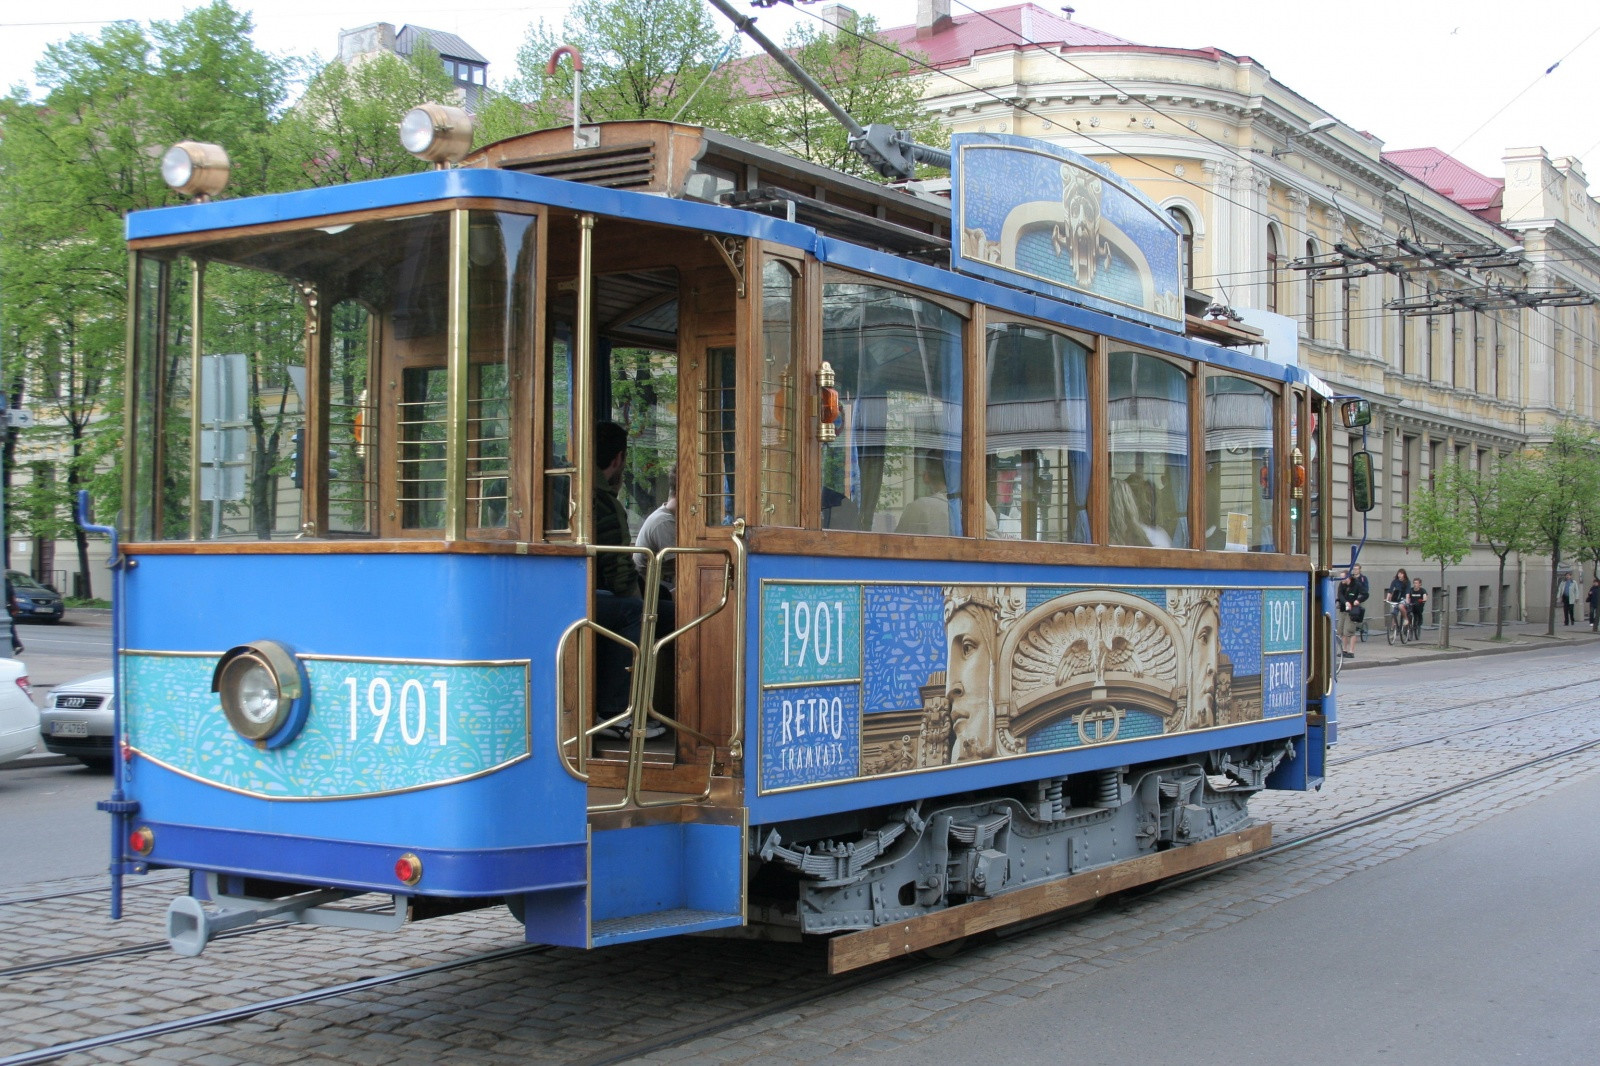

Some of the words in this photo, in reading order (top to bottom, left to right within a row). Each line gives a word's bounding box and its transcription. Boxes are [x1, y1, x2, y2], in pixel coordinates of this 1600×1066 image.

[780, 601, 843, 667] 1901
[1268, 600, 1295, 642] 1901
[1268, 661, 1295, 692] RETRO
[344, 676, 448, 746] 1901
[781, 696, 843, 745] RETRO
[780, 742, 844, 771] TRAMVAJS
